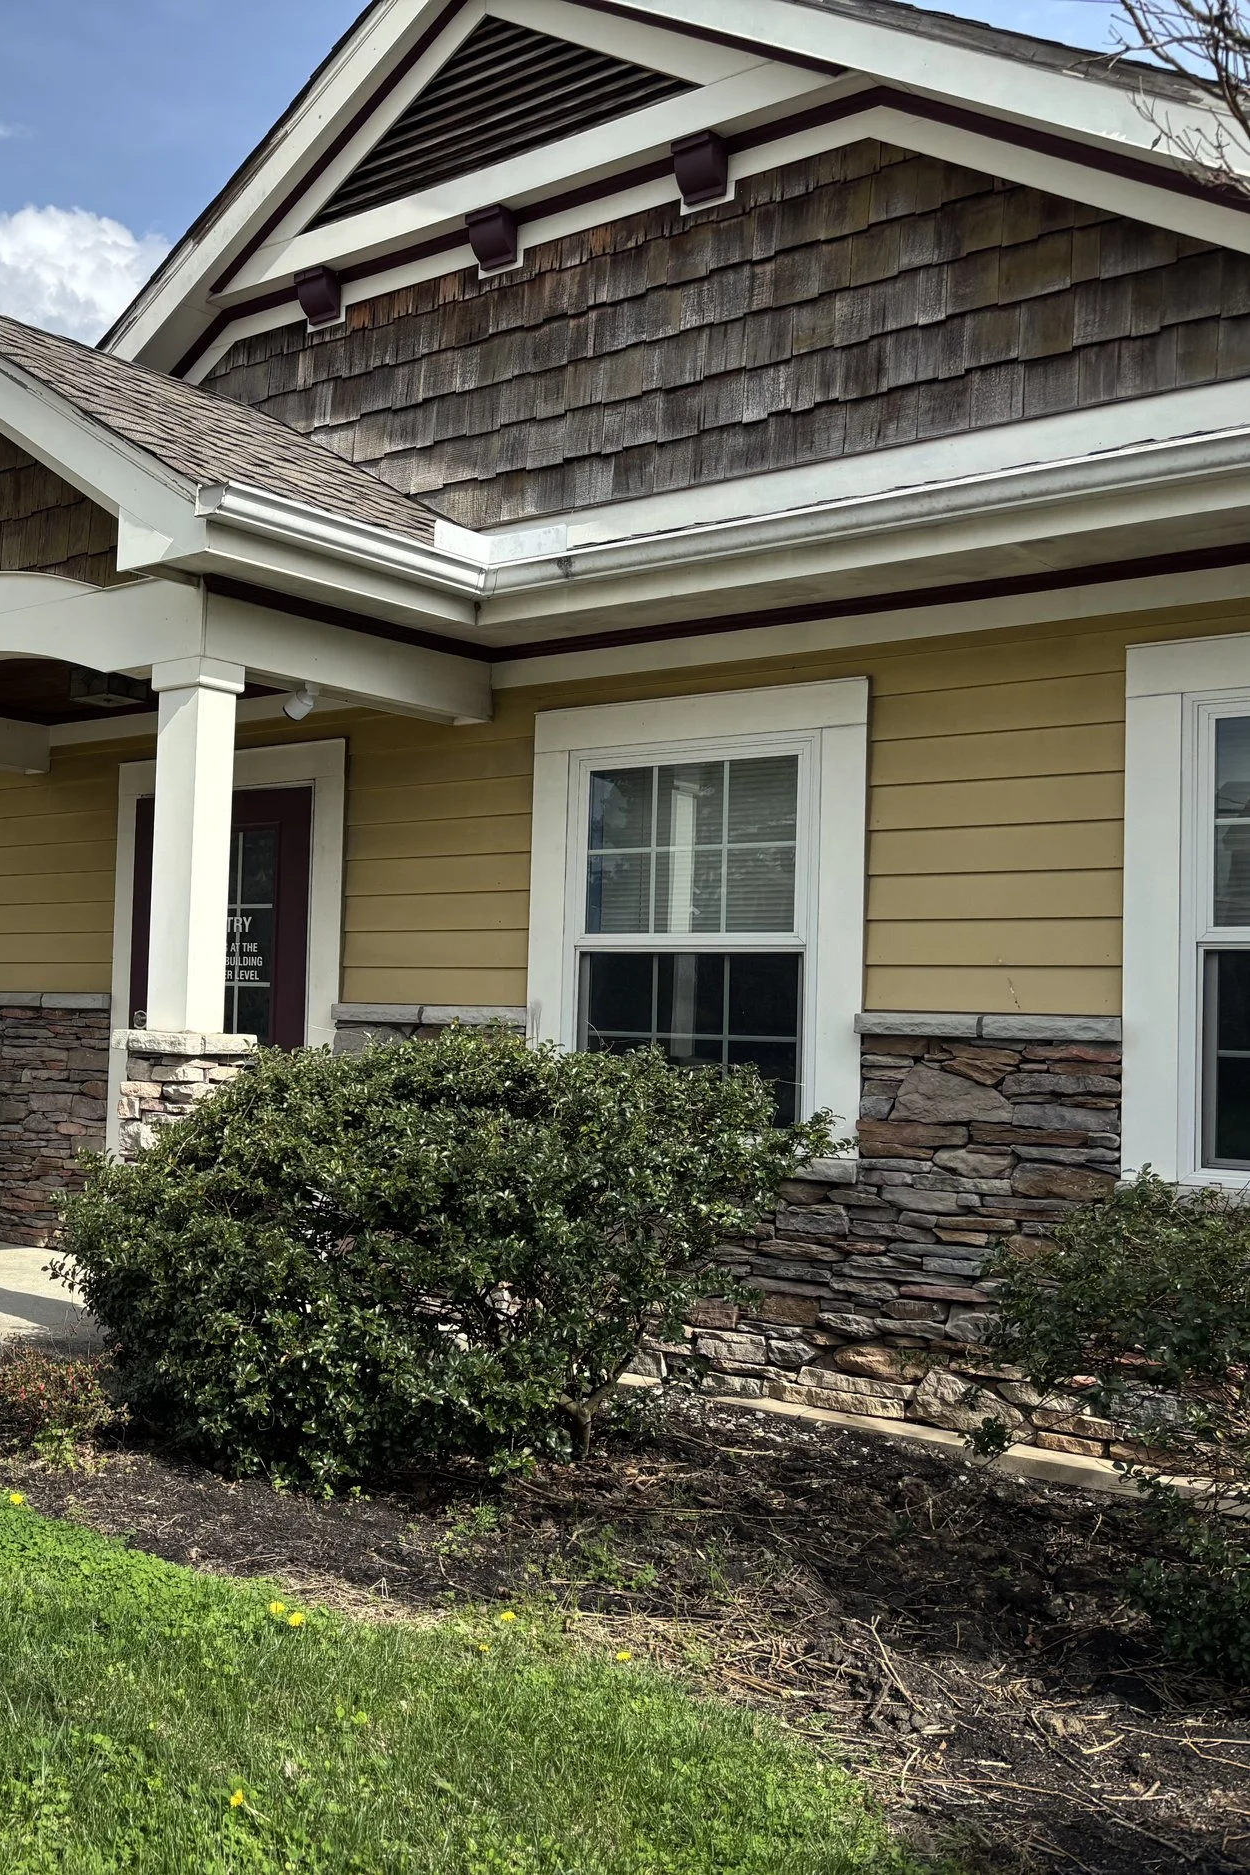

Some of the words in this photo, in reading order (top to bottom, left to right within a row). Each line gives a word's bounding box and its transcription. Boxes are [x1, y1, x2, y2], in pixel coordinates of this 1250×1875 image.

[230, 942, 241, 952] AT
[241, 942, 258, 952] THE
[225, 956, 263, 967] BUILDING
[235, 970, 259, 980] LEVEL
